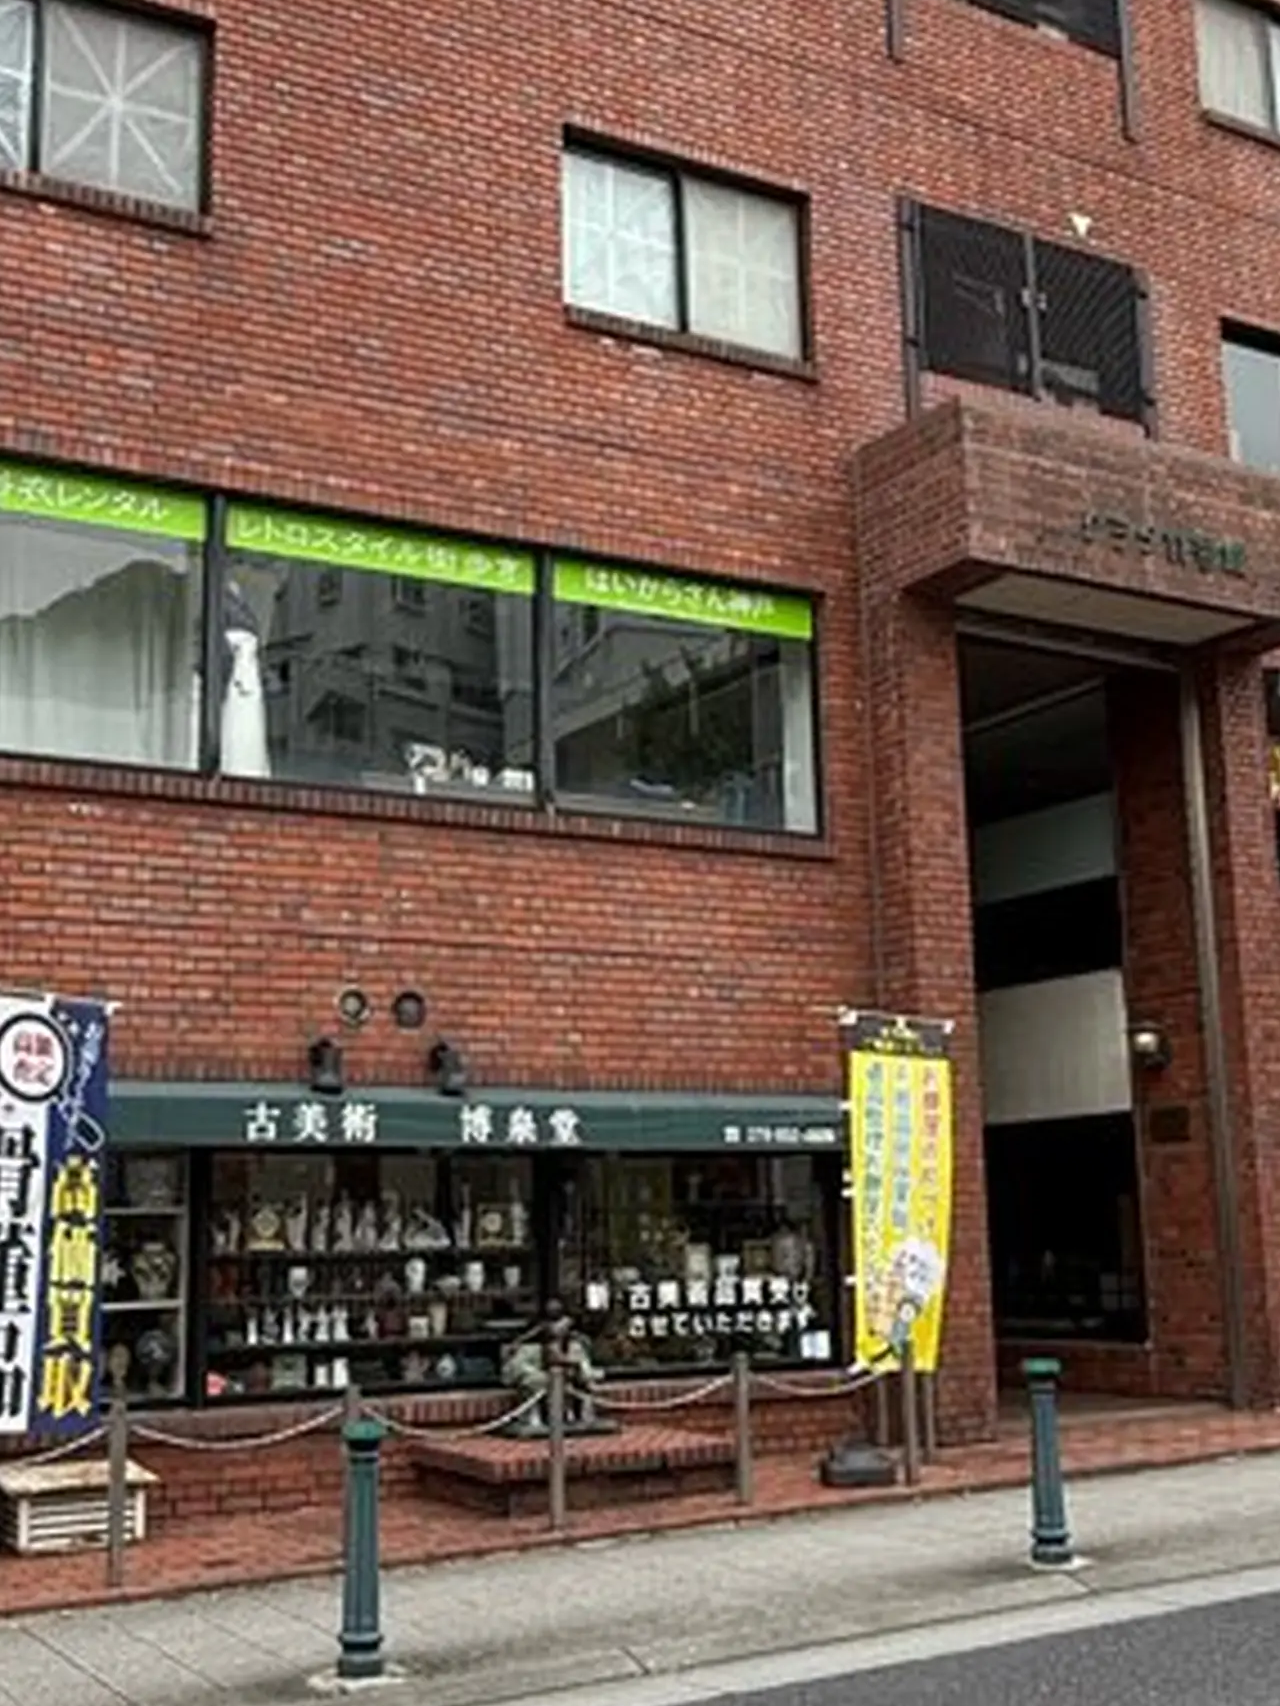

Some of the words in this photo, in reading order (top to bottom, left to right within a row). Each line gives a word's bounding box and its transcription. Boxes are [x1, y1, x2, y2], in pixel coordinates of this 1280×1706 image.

[244, 1102, 377, 1142] 古美術
[459, 1103, 582, 1144] 博泉堂
[37, 1155, 100, 1419] 高価買取
